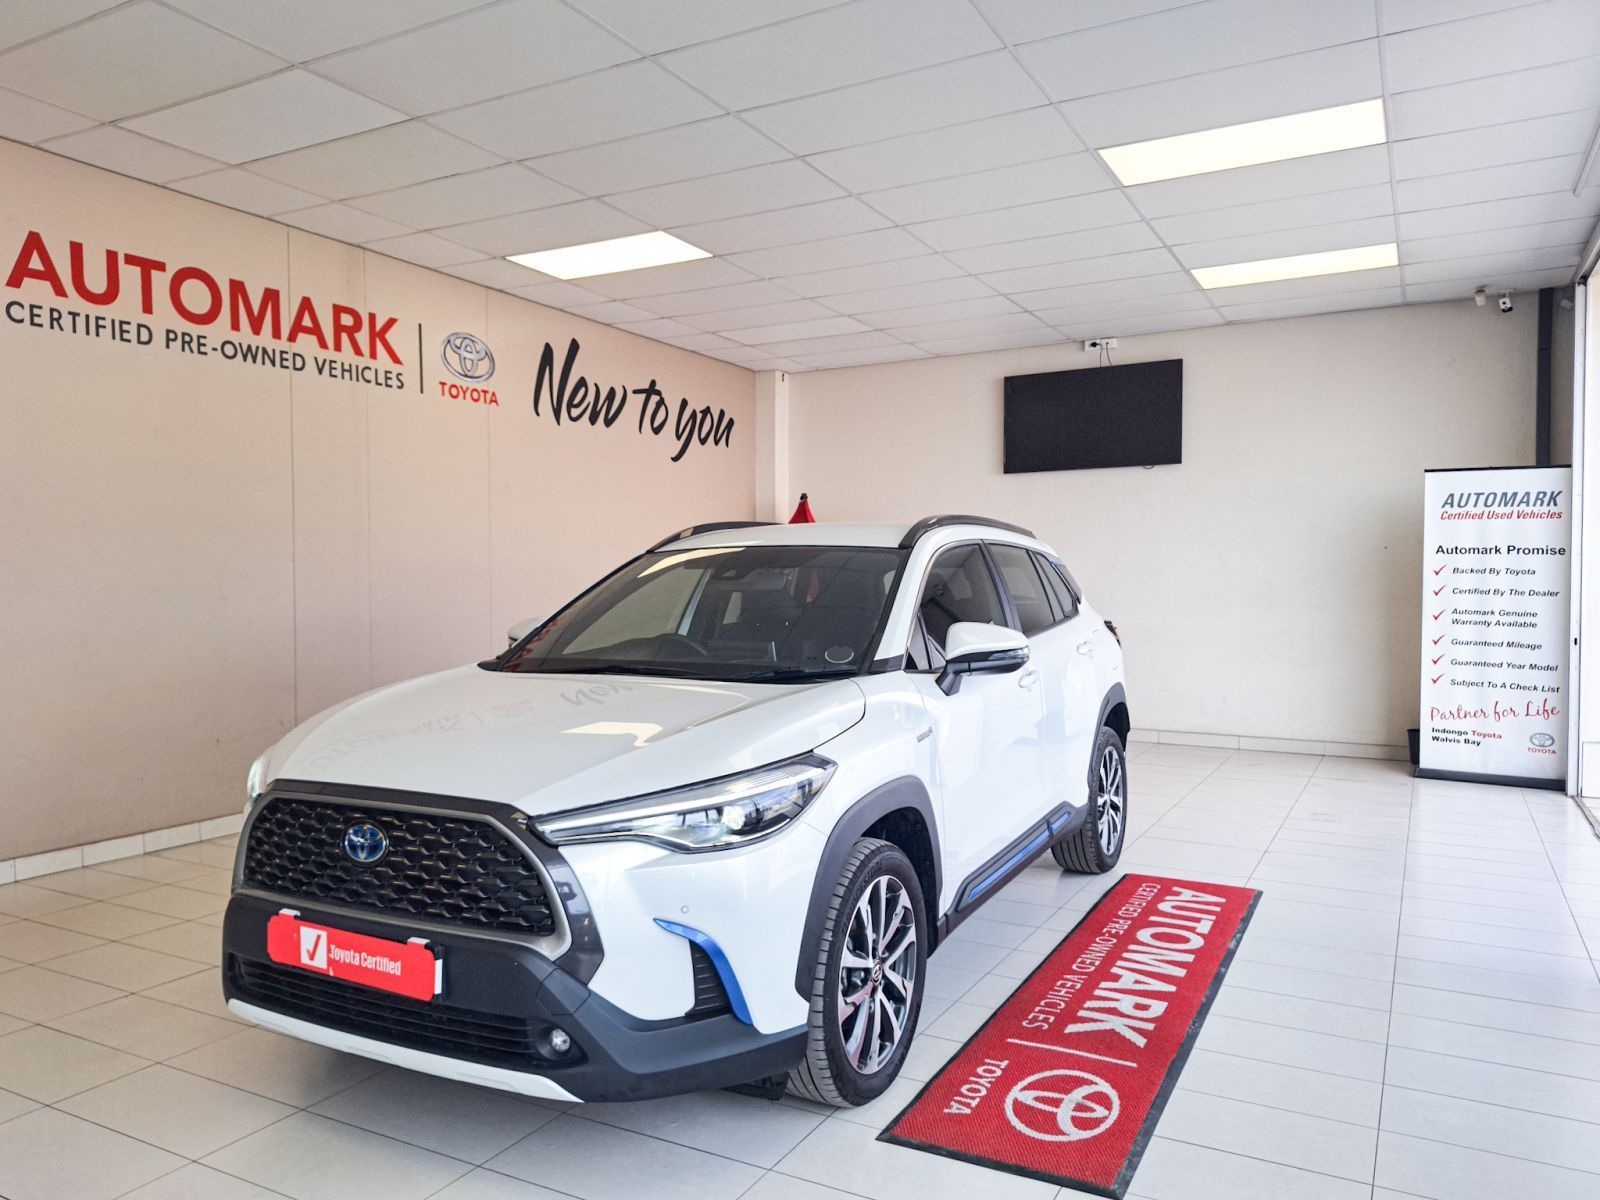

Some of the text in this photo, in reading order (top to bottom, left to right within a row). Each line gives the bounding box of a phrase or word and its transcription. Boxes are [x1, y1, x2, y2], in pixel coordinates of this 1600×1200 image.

[5, 230, 404, 365] AUTOMARK
[5, 300, 404, 389] CERTIFIED PRE-OWNED VEHICLES
[438, 381, 499, 406] TOYOTA
[533, 338, 735, 462] New to you
[1441, 490, 1563, 508] AUTOMARK
[1440, 509, 1563, 521] Certified Used Vehicles
[1435, 545, 1566, 555] Automark Promise
[1452, 567, 1536, 576] Backed By Toyota
[1452, 587, 1560, 597] Certified By The Dealer
[1451, 608, 1538, 618] Automark Genuine
[1451, 618, 1537, 629] Warranty Available
[1451, 638, 1542, 651] Guaranteed Mileage
[1450, 658, 1559, 672] Guaranteed Year Model
[1450, 678, 1485, 688] Subject
[1500, 681, 1507, 689] A
[1509, 682, 1538, 692] Check
[1541, 685, 1560, 693] List
[1430, 698, 1560, 722] Partner for Life
[1431, 727, 1502, 739] Indongo Toyota
[1431, 736, 1482, 747] Walvis Bay
[330, 944, 401, 976] Toyota Certified
[1022, 883, 1161, 1031] CERTIFIED PRE-OWNED VEHICLES
[1063, 886, 1226, 1048] AUTOMARK
[943, 1058, 1009, 1115] TOYOTA
